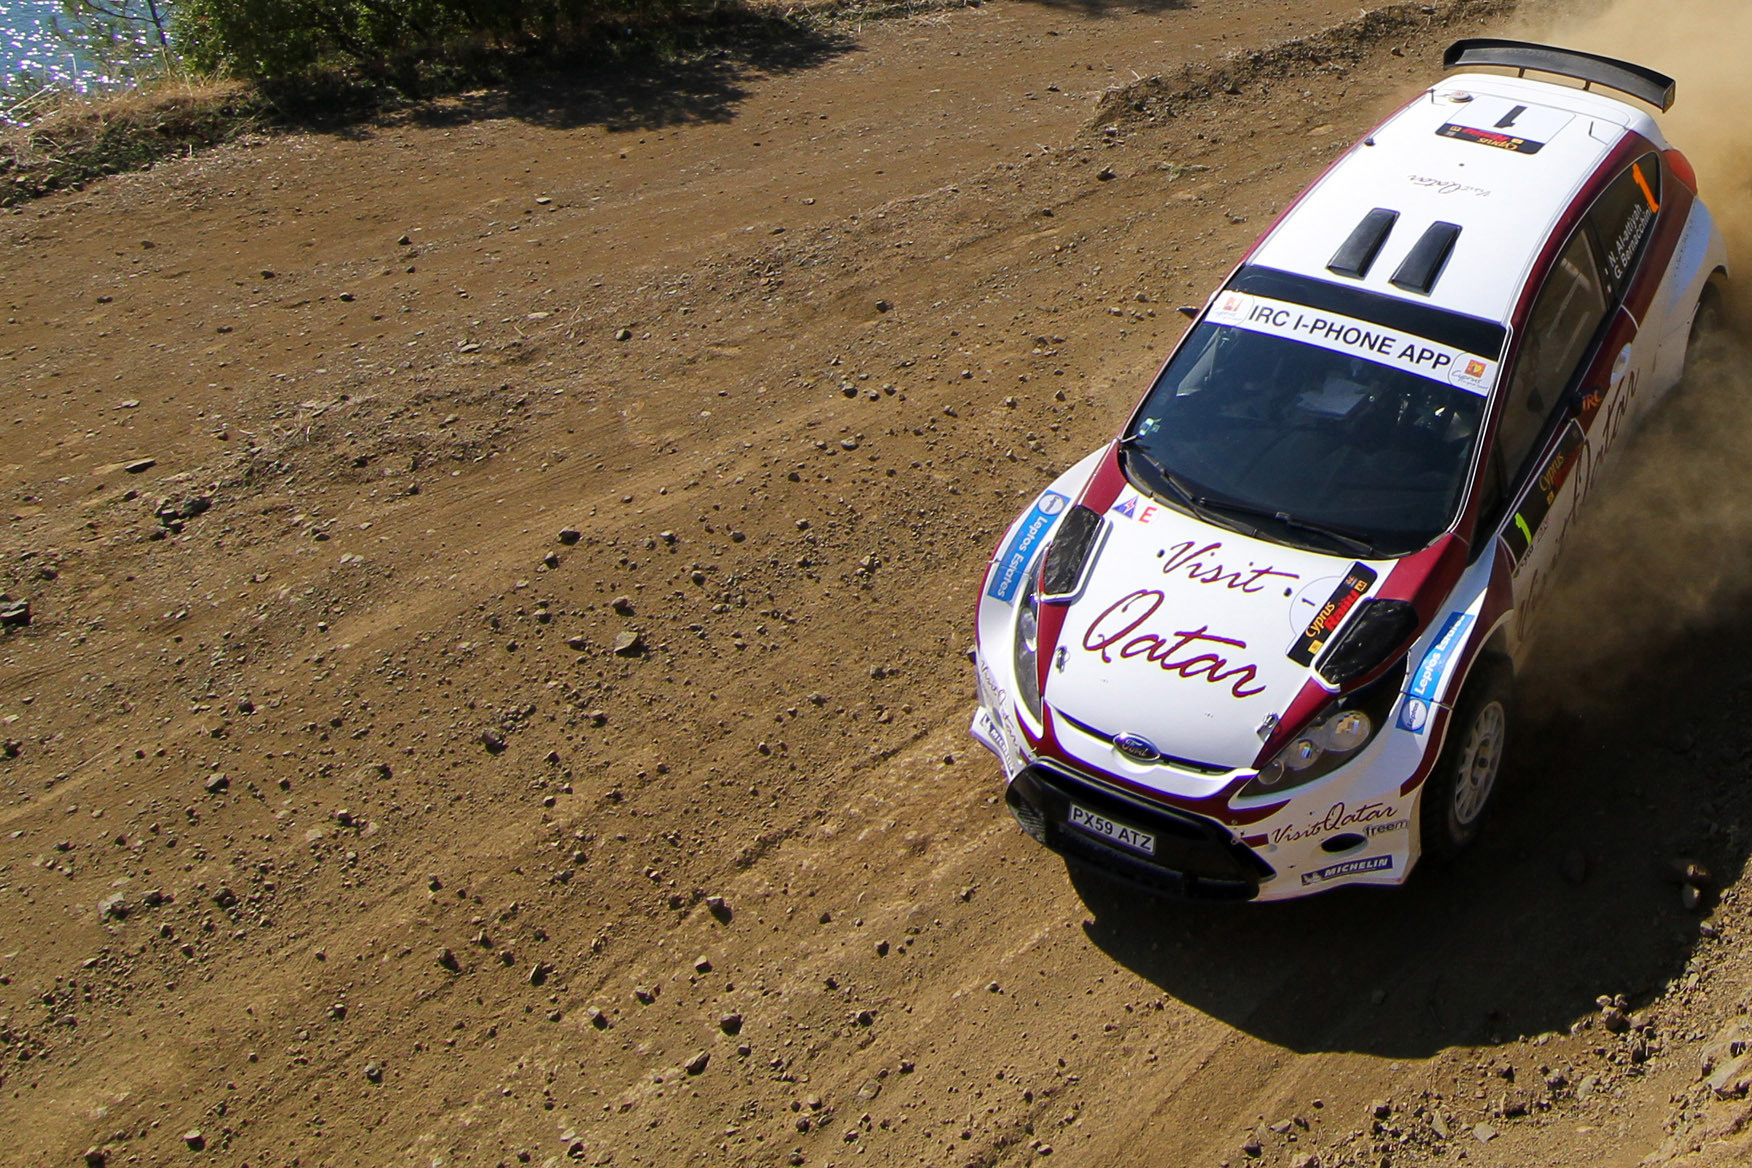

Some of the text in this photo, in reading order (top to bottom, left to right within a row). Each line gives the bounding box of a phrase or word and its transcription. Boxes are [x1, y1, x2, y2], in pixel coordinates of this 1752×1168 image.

[1493, 105, 1528, 129] 1
[1632, 163, 1660, 213] 1
[1248, 305, 1290, 327] IRC
[1293, 314, 1397, 356] I-PHONE
[1397, 344, 1452, 370] APP
[1138, 507, 1157, 524] E
[1514, 512, 1532, 545] 1
[1018, 516, 1048, 553] Leptos
[997, 554, 1025, 598] Estates
[1163, 541, 1300, 593] Visit
[1301, 597, 1316, 607] 1
[1305, 601, 1336, 638] Cyprus
[1083, 589, 1266, 698] Qatar
[1414, 651, 1442, 695] Leptos
[1120, 738, 1149, 758] Ford
[1072, 807, 1153, 851] PX59 ATZ
[1324, 858, 1388, 877] MICHELIN
